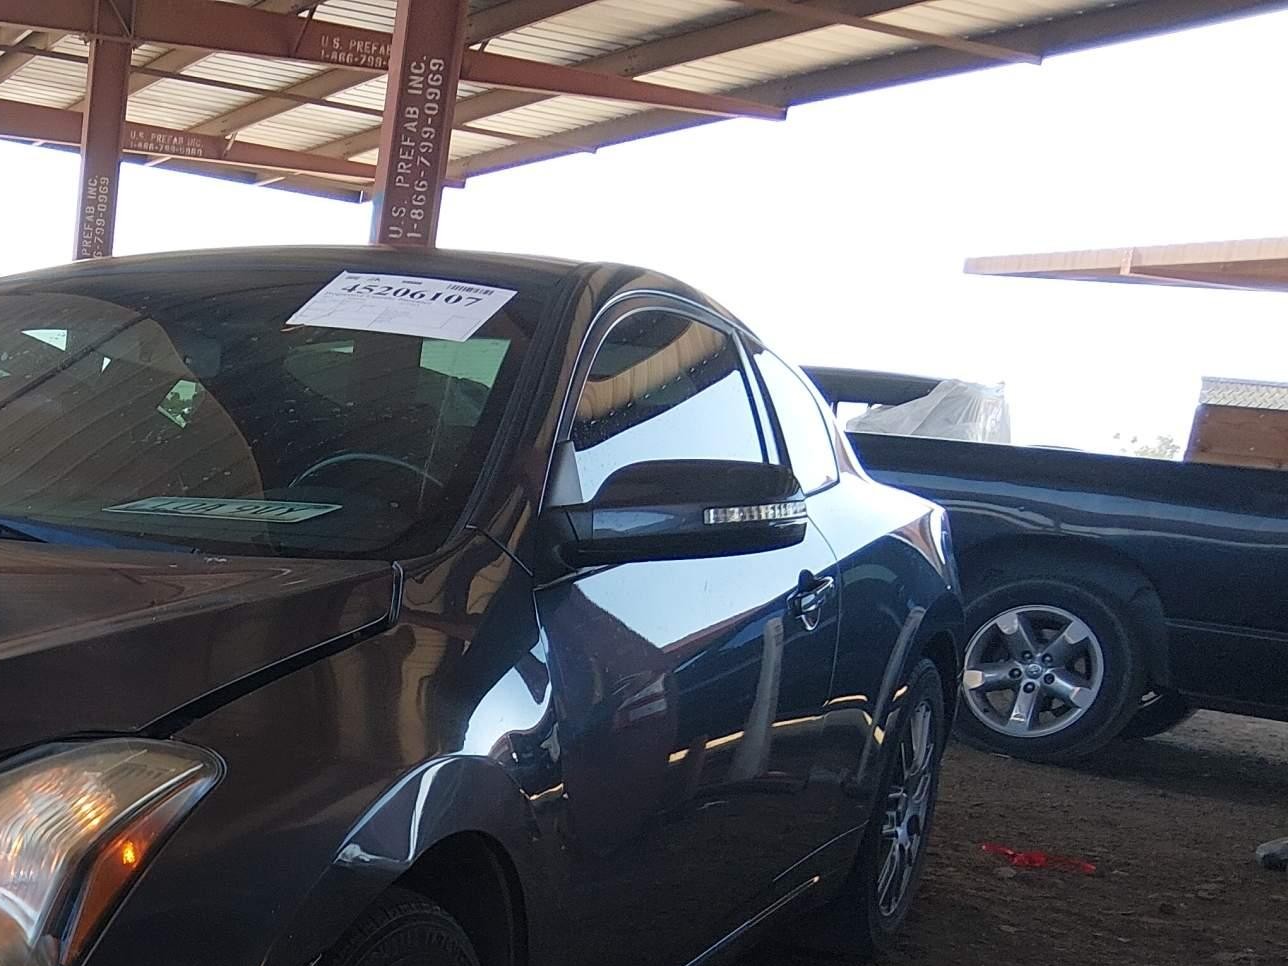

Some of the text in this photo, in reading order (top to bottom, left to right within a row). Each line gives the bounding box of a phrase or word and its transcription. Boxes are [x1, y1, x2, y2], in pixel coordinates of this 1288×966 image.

[388, 55, 427, 239] U.S. PREFAB INC.
[407, 58, 445, 238] 1-866-799-0969
[82, 175, 98, 257] PREFAB INC.
[341, 283, 483, 308] 45206107
